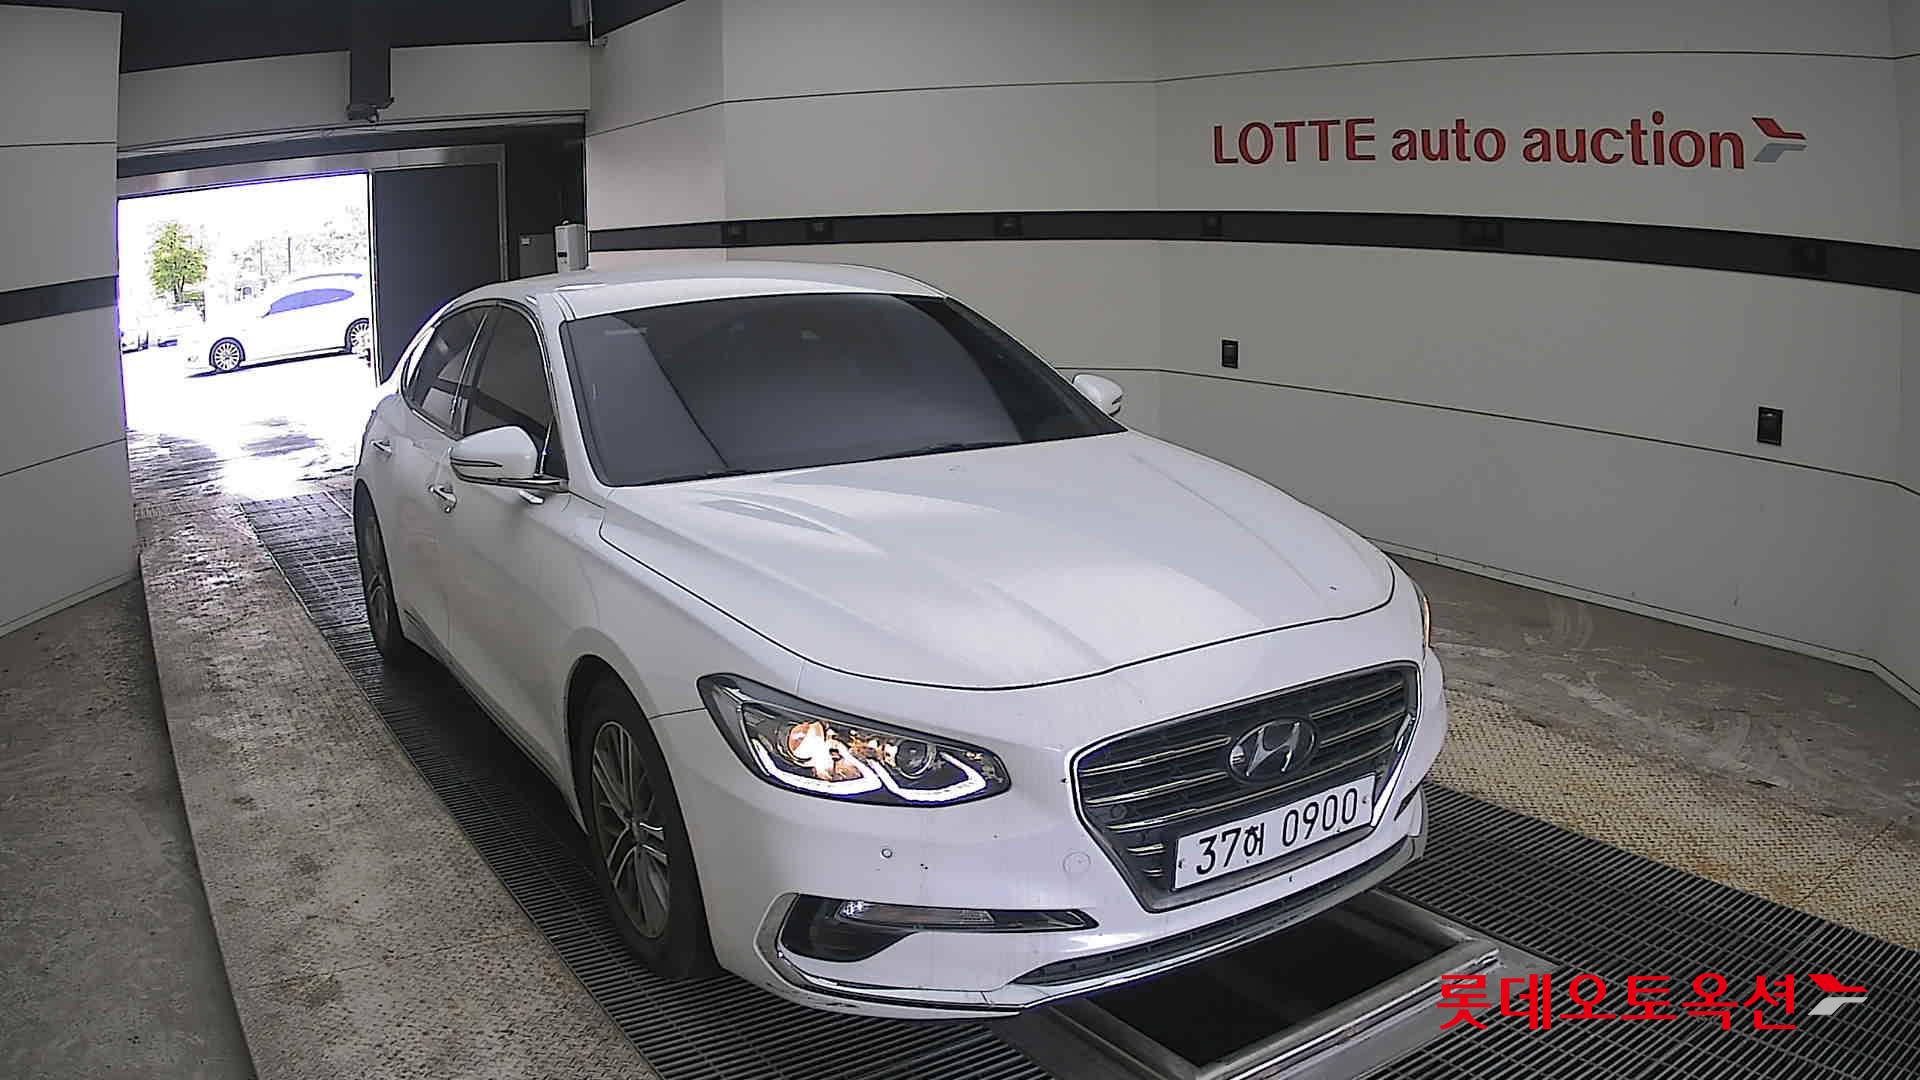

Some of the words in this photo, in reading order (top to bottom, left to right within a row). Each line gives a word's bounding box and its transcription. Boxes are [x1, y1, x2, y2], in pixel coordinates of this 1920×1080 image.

[1213, 117, 1376, 164] LOTTE
[1391, 118, 1507, 163] auto
[1521, 111, 1746, 170] auction
[1196, 822, 1265, 875] 37허
[1282, 788, 1358, 847] 0900
